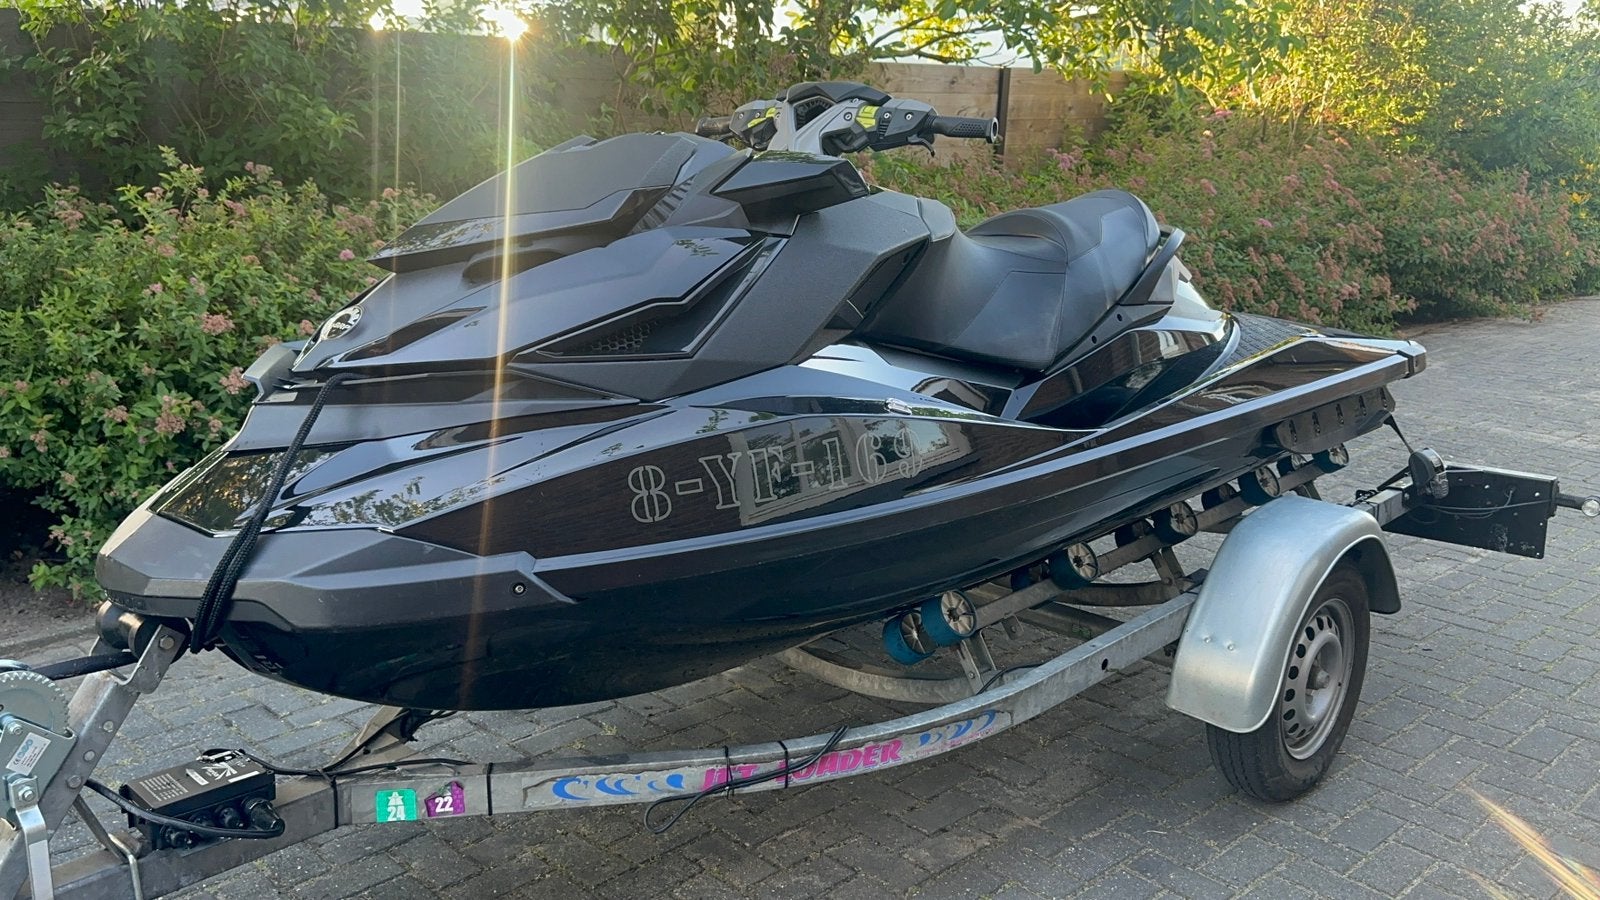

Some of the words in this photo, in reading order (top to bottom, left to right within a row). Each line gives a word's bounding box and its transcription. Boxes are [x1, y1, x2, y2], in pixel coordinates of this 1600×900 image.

[628, 428, 922, 522] 8-YF-169
[435, 796, 454, 812] 22
[387, 805, 406, 821] 24
